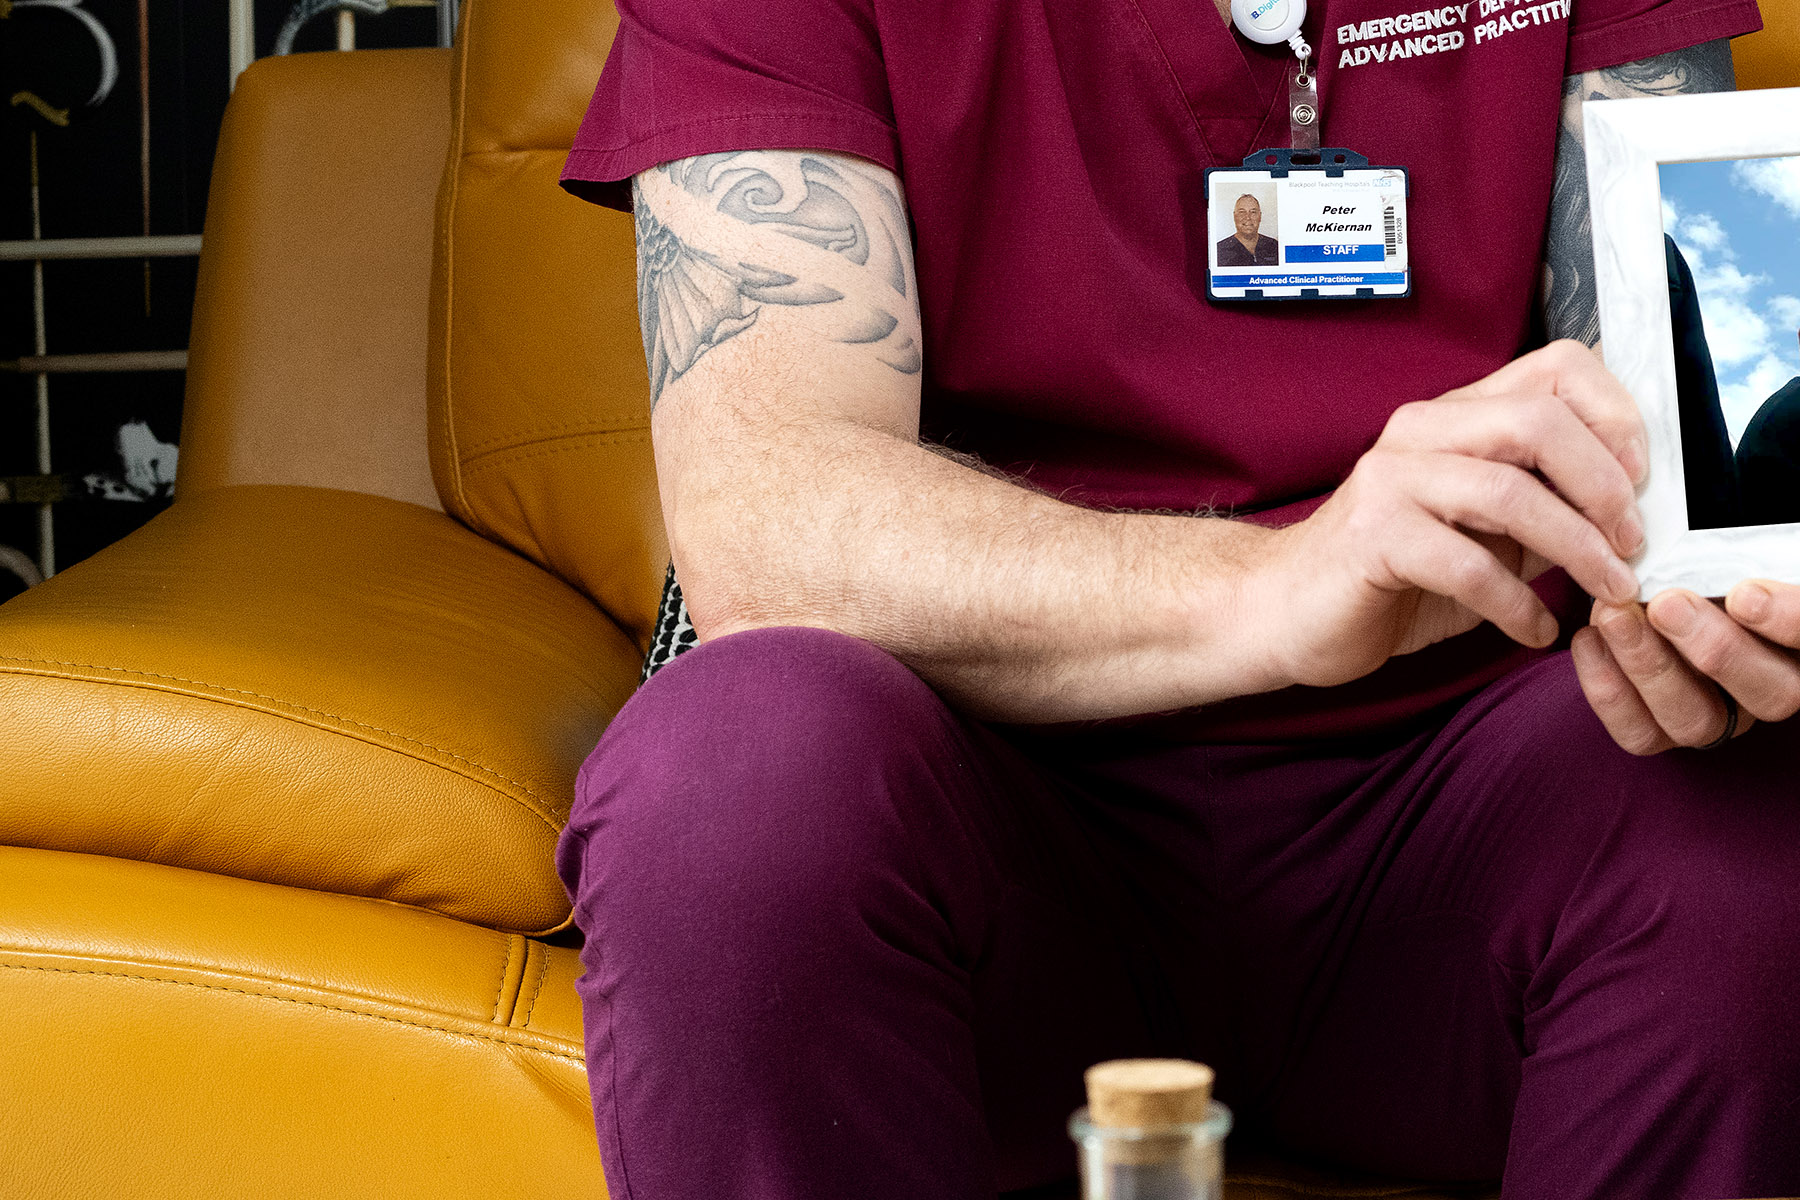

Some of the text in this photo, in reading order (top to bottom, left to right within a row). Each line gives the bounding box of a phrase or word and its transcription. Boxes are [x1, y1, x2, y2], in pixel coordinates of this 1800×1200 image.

[1337, 2, 1470, 45] EMERGENCY
[1338, 30, 1465, 69] ADVANCED
[1322, 205, 1356, 215] Peter
[1305, 222, 1372, 232] McKiernan
[1323, 245, 1360, 255] STAFF
[1249, 275, 1364, 285] Advanced Clinical Practitioner
